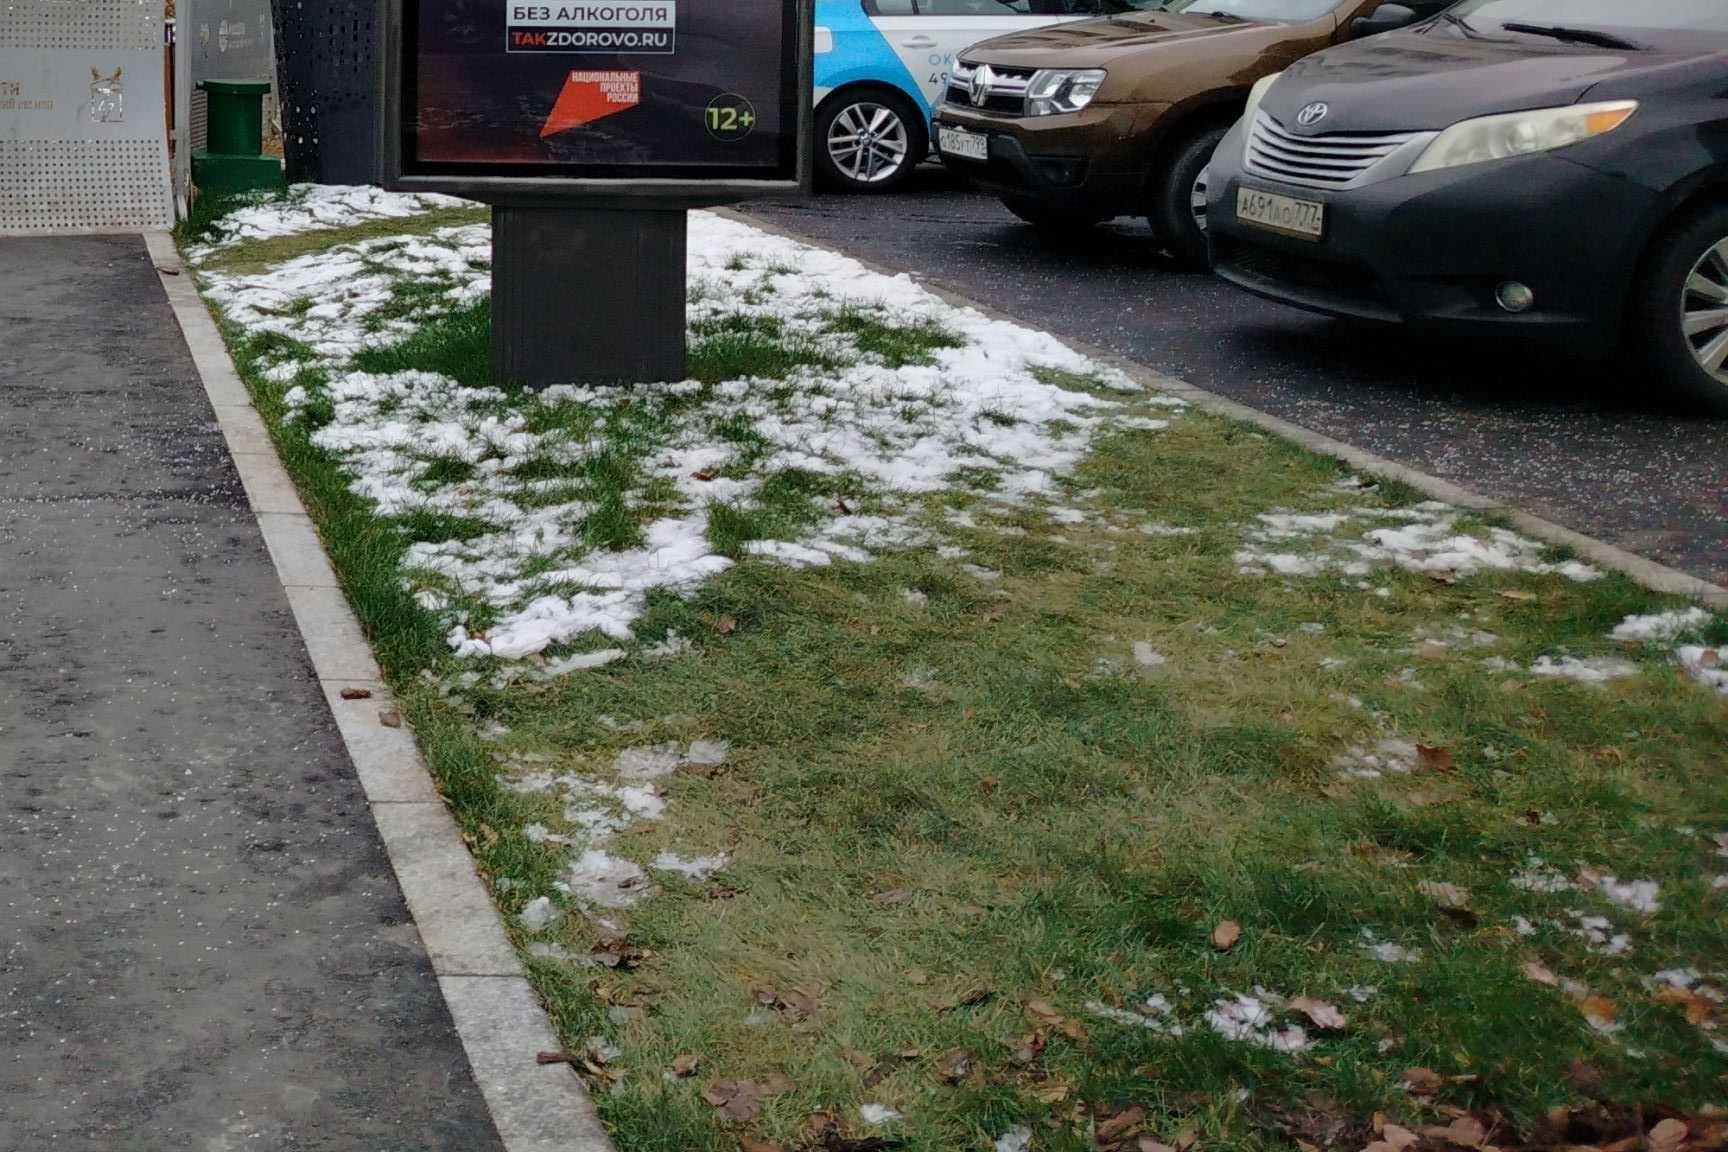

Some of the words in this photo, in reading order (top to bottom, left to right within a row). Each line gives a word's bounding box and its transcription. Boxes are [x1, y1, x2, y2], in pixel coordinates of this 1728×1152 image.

[513, 6, 551, 21] БЕЗ
[555, 6, 668, 22] АЛКОГОЛЯ
[571, 71, 640, 82] НАЦИОНАЛЬНЫЕ
[599, 82, 640, 93] ПРОЕКТЫ
[607, 92, 640, 103] РОССИИ
[707, 106, 754, 131] 12+
